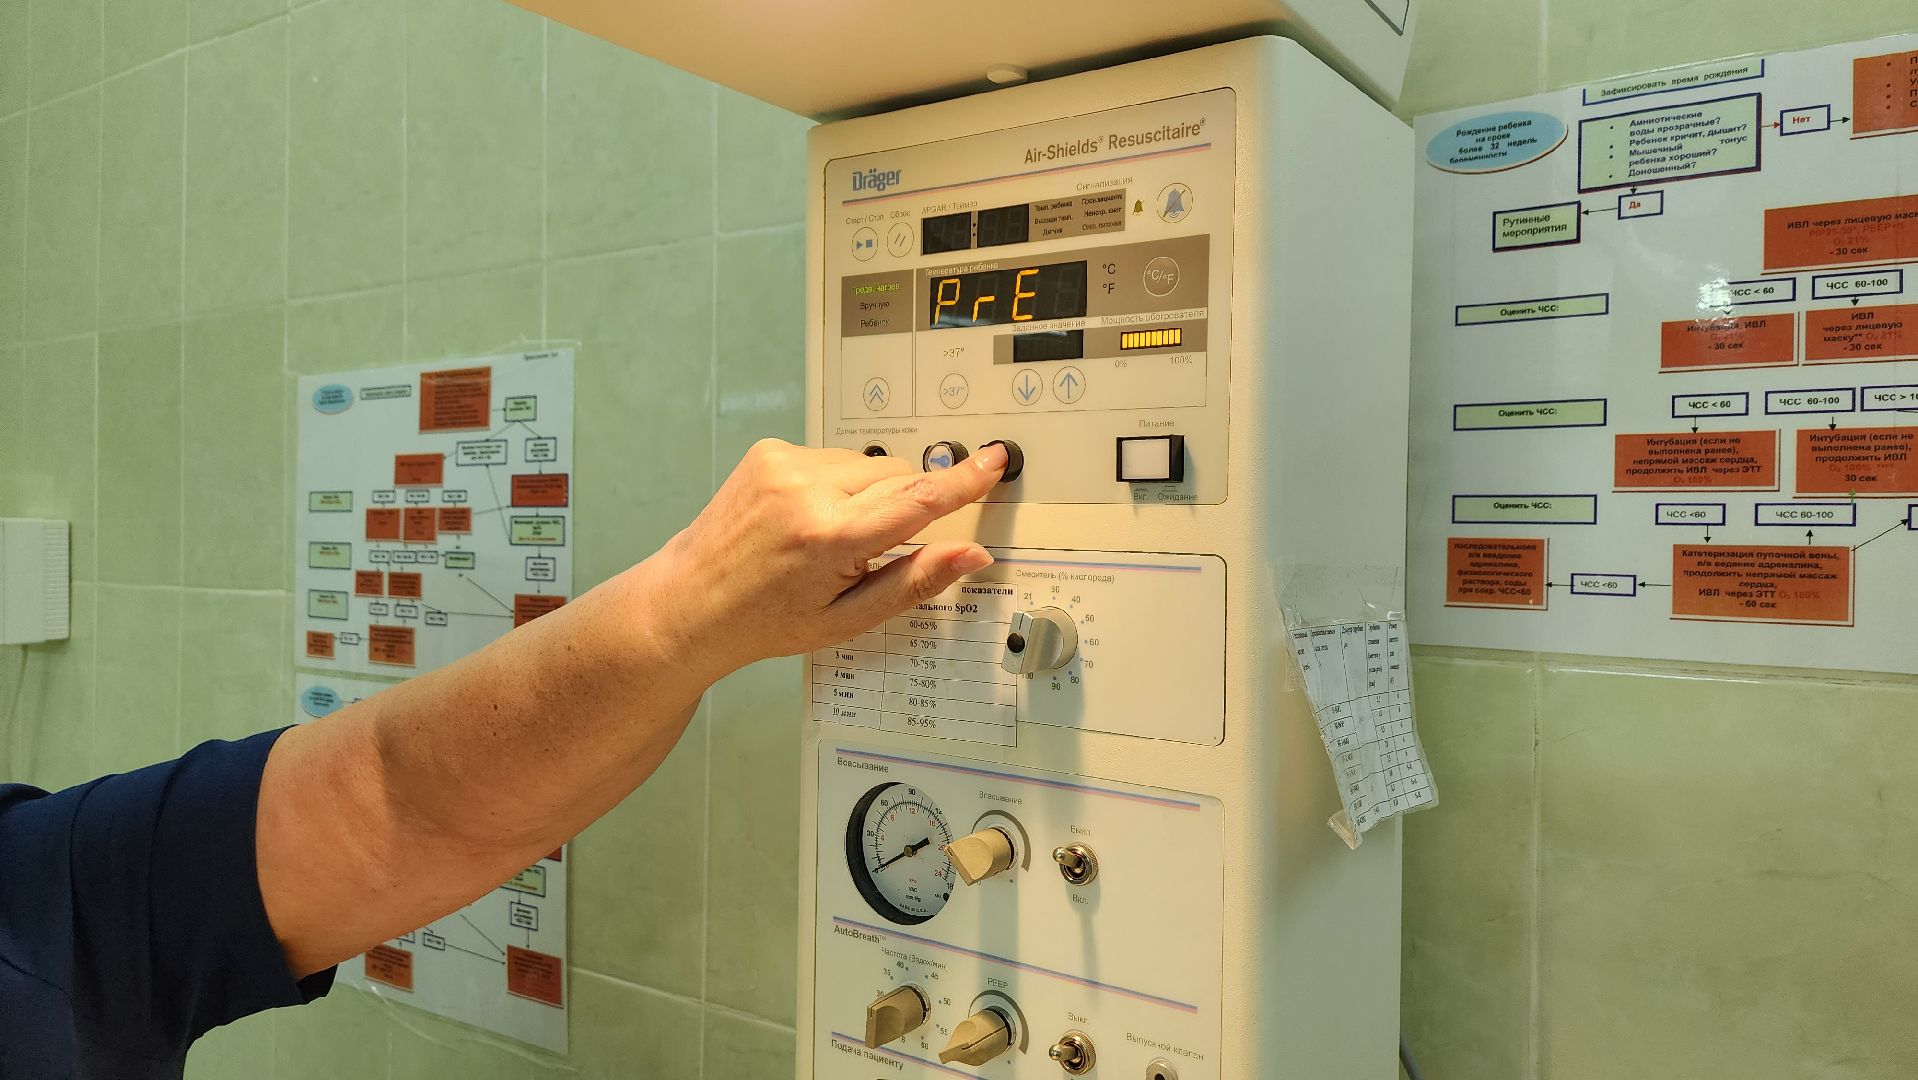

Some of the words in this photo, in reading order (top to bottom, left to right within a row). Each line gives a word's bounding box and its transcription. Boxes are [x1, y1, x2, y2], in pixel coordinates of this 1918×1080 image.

[1703, 67, 1748, 81] рождения
[1629, 111, 1703, 127] Амниотические
[1792, 115, 1812, 125] Нет
[1456, 125, 1496, 138] Рождение
[1629, 127, 1655, 137] воды
[1657, 117, 1721, 133] прозрачные?
[1629, 136, 1668, 147] Ребенок
[1720, 135, 1748, 145] тонус
[1490, 142, 1500, 150] 32
[1668, 148, 1718, 162] хороший?
[852, 168, 901, 192] Dräger
[1628, 200, 1641, 210] Да
[1502, 214, 1551, 228] Рутинные
[1787, 220, 1809, 230] ИВЛ
[1502, 223, 1568, 238] мероприятия
[1826, 281, 1849, 290] ЧСС
[1855, 278, 1888, 289] 60-100
[1762, 286, 1774, 294] 60
[934, 268, 1040, 326] PrE
[1499, 307, 1536, 317] Оценить
[1851, 311, 1874, 321] ИВЛ
[1114, 360, 1127, 368] 0%
[1779, 397, 1802, 406] ЧСС
[1807, 396, 1840, 405] 60-100
[1874, 393, 1897, 402] ЧСС
[1688, 401, 1709, 410] ЧСС
[1720, 400, 1731, 409] 60
[1498, 409, 1534, 418] Оценить
[1883, 452, 1907, 461] ИВЛ
[1686, 465, 1707, 474] ИВЛ
[1742, 465, 1762, 474] ЭТТ
[1157, 492, 1198, 502] Ожидание
[1493, 501, 1529, 511] Оценить
[1666, 509, 1687, 518] ЧСС
[1776, 510, 1798, 519] ЧСС
[1800, 510, 1834, 519] 60-100
[1051, 585, 1060, 594] 30
[1580, 580, 1600, 589] ЧСС
[961, 586, 1014, 597] показатели
[1024, 592, 1032, 600] 21
[1698, 588, 1720, 598] ИВЛ
[1755, 589, 1776, 599] ЭТТ
[1071, 595, 1081, 603] 40
[954, 602, 978, 614] SpO2
[1085, 614, 1095, 623] 50
[1089, 638, 1099, 646] 60
[1085, 660, 1094, 669] 70
[1051, 682, 1061, 691] 90
[880, 799, 888, 807] 60
[943, 997, 951, 1005] 50
[831, 1039, 862, 1057] Подача
